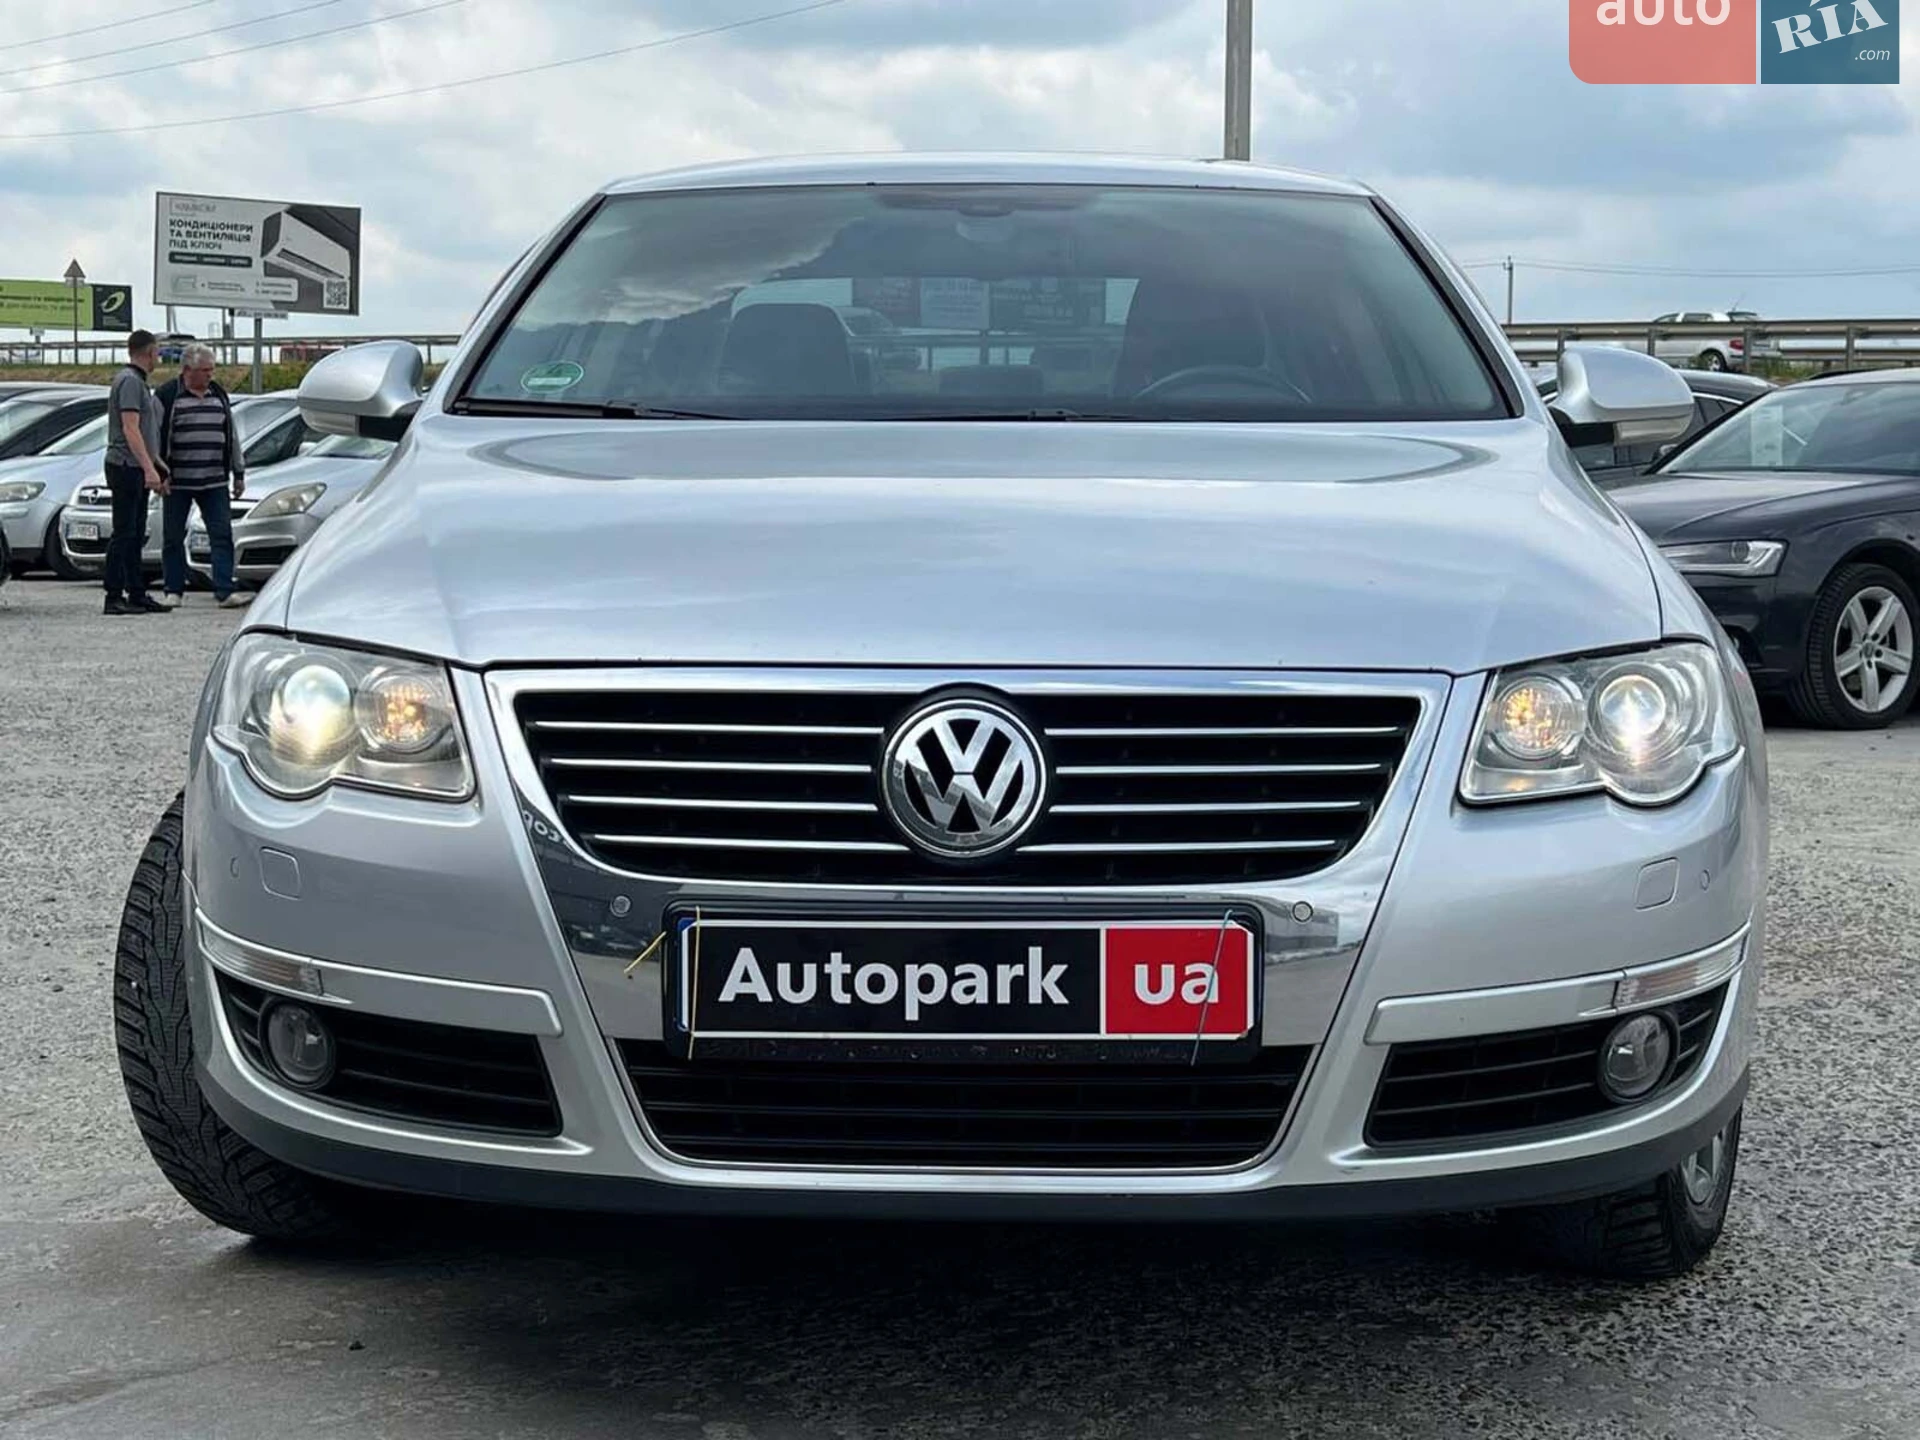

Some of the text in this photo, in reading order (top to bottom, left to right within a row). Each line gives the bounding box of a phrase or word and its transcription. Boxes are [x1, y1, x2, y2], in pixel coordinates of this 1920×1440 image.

[169, 219, 254, 232] КОНДИЦІОНЕРИ
[170, 228, 183, 238] ТА
[169, 239, 222, 250] ПІД КЛЮЧ
[718, 946, 1219, 1021] Autopark ua
